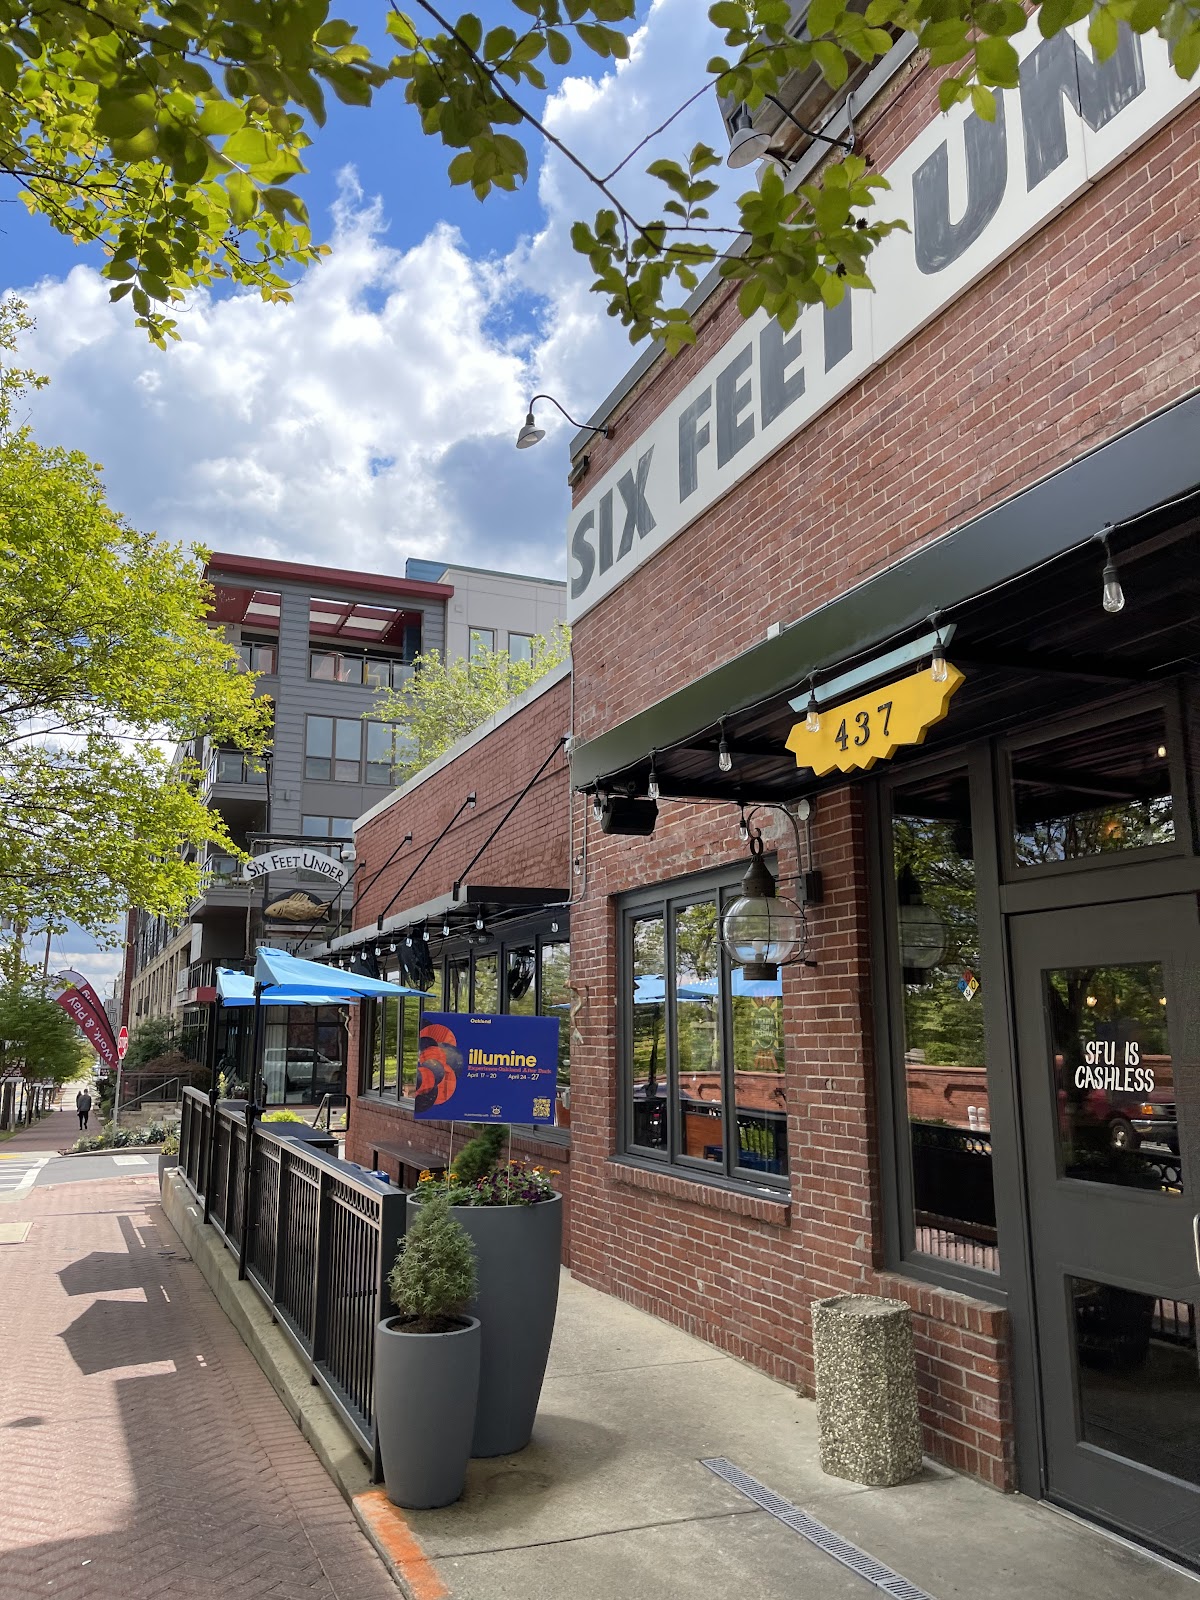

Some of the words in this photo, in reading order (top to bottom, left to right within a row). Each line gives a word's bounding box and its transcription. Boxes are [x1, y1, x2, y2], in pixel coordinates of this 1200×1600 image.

[570, 444, 657, 600] SIX
[912, 0, 1200, 276] UN
[835, 701, 893, 752] 437
[271, 854, 301, 870] FEET
[303, 853, 344, 882] UNDER
[66, 996, 89, 1021] Play
[468, 1048, 537, 1067] illumine
[1084, 1041, 1116, 1066] SFU
[1124, 1041, 1140, 1066] IS
[531, 1073, 540, 1081] 27
[1074, 1065, 1155, 1093] CASHLESS
